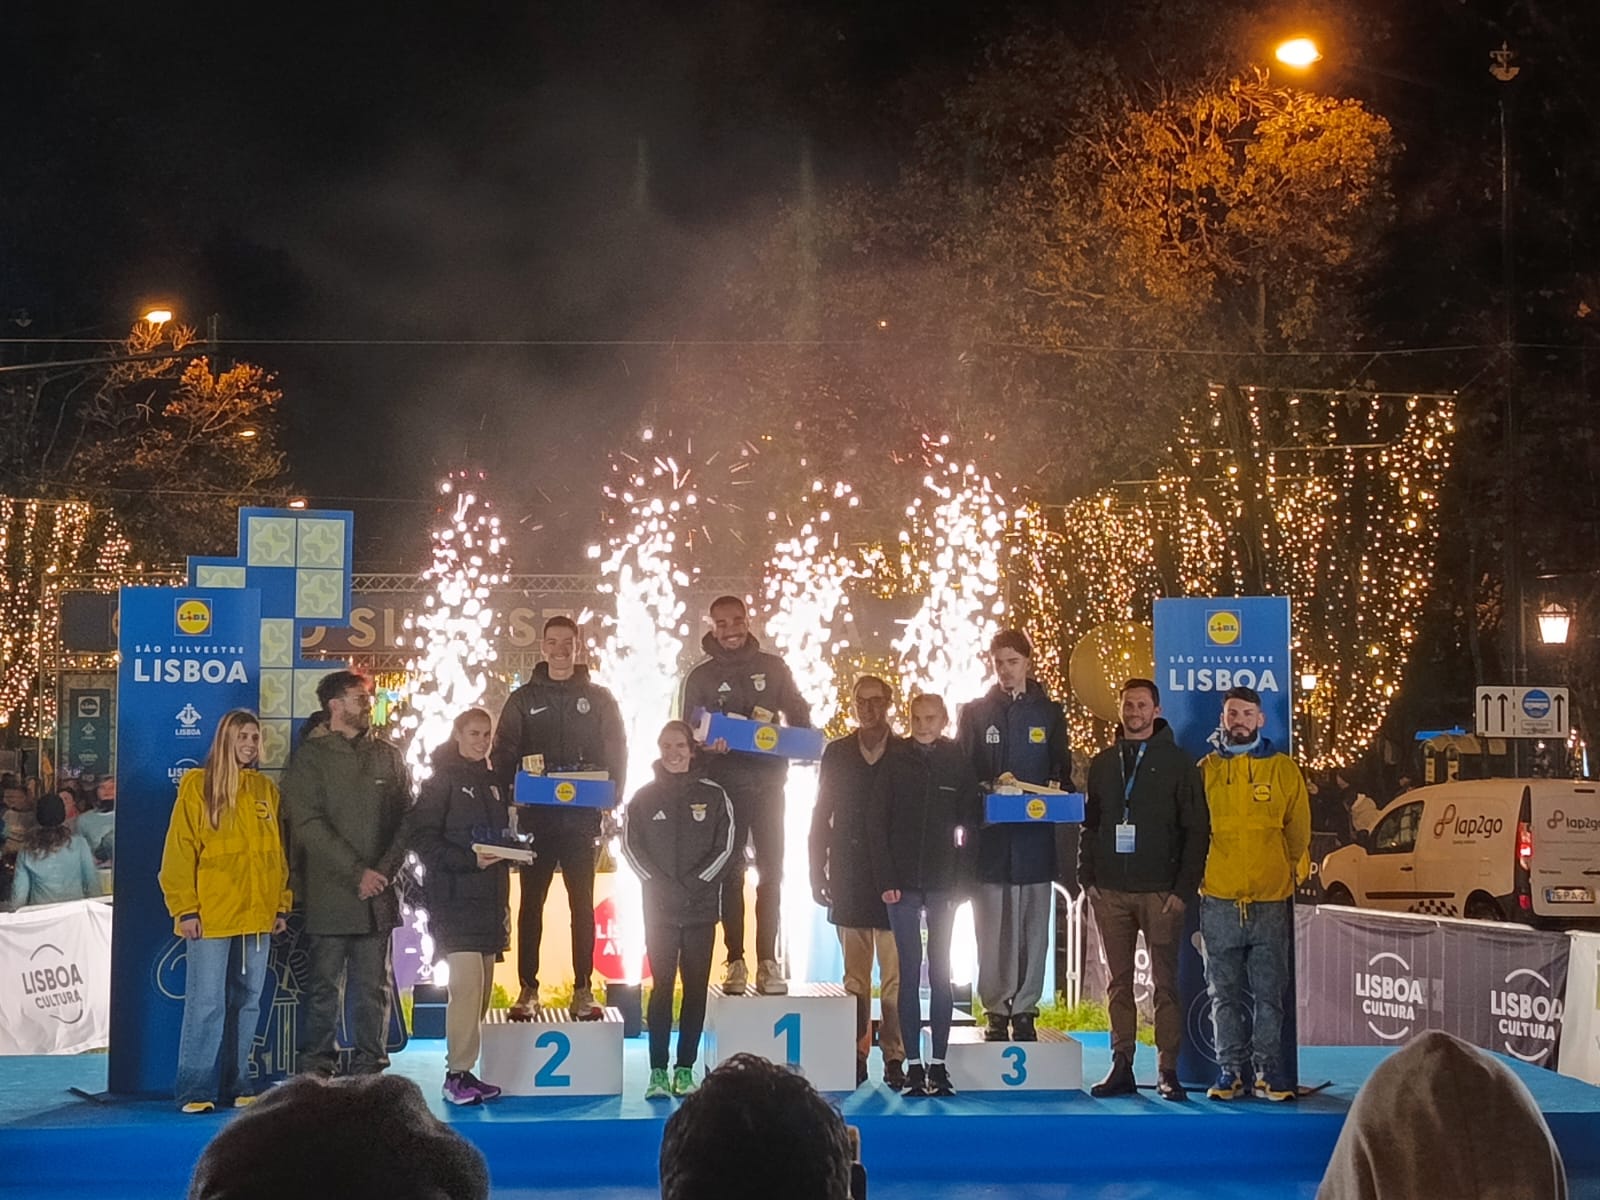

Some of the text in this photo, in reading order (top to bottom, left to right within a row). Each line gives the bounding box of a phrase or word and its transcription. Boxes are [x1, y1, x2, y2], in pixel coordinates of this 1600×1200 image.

[135, 643, 245, 654] SÃO SILVESTRE
[1169, 654, 1275, 664] SÃO SILVESTRE
[134, 658, 249, 684] LISBOA
[1169, 669, 1279, 692] LISBOA
[175, 728, 202, 736] LISBOA
[1454, 815, 1503, 839] lap2go
[22, 963, 83, 995] LISBOA
[1356, 973, 1424, 1005] LISBOA
[35, 989, 82, 1009] CULTURA
[1361, 999, 1416, 1022] CULTURA
[1490, 989, 1566, 1024] LISBOA
[773, 1012, 802, 1066] 1
[1498, 1018, 1557, 1042] CULTURA
[534, 1030, 572, 1088] 2
[1000, 1045, 1028, 1087] 3
